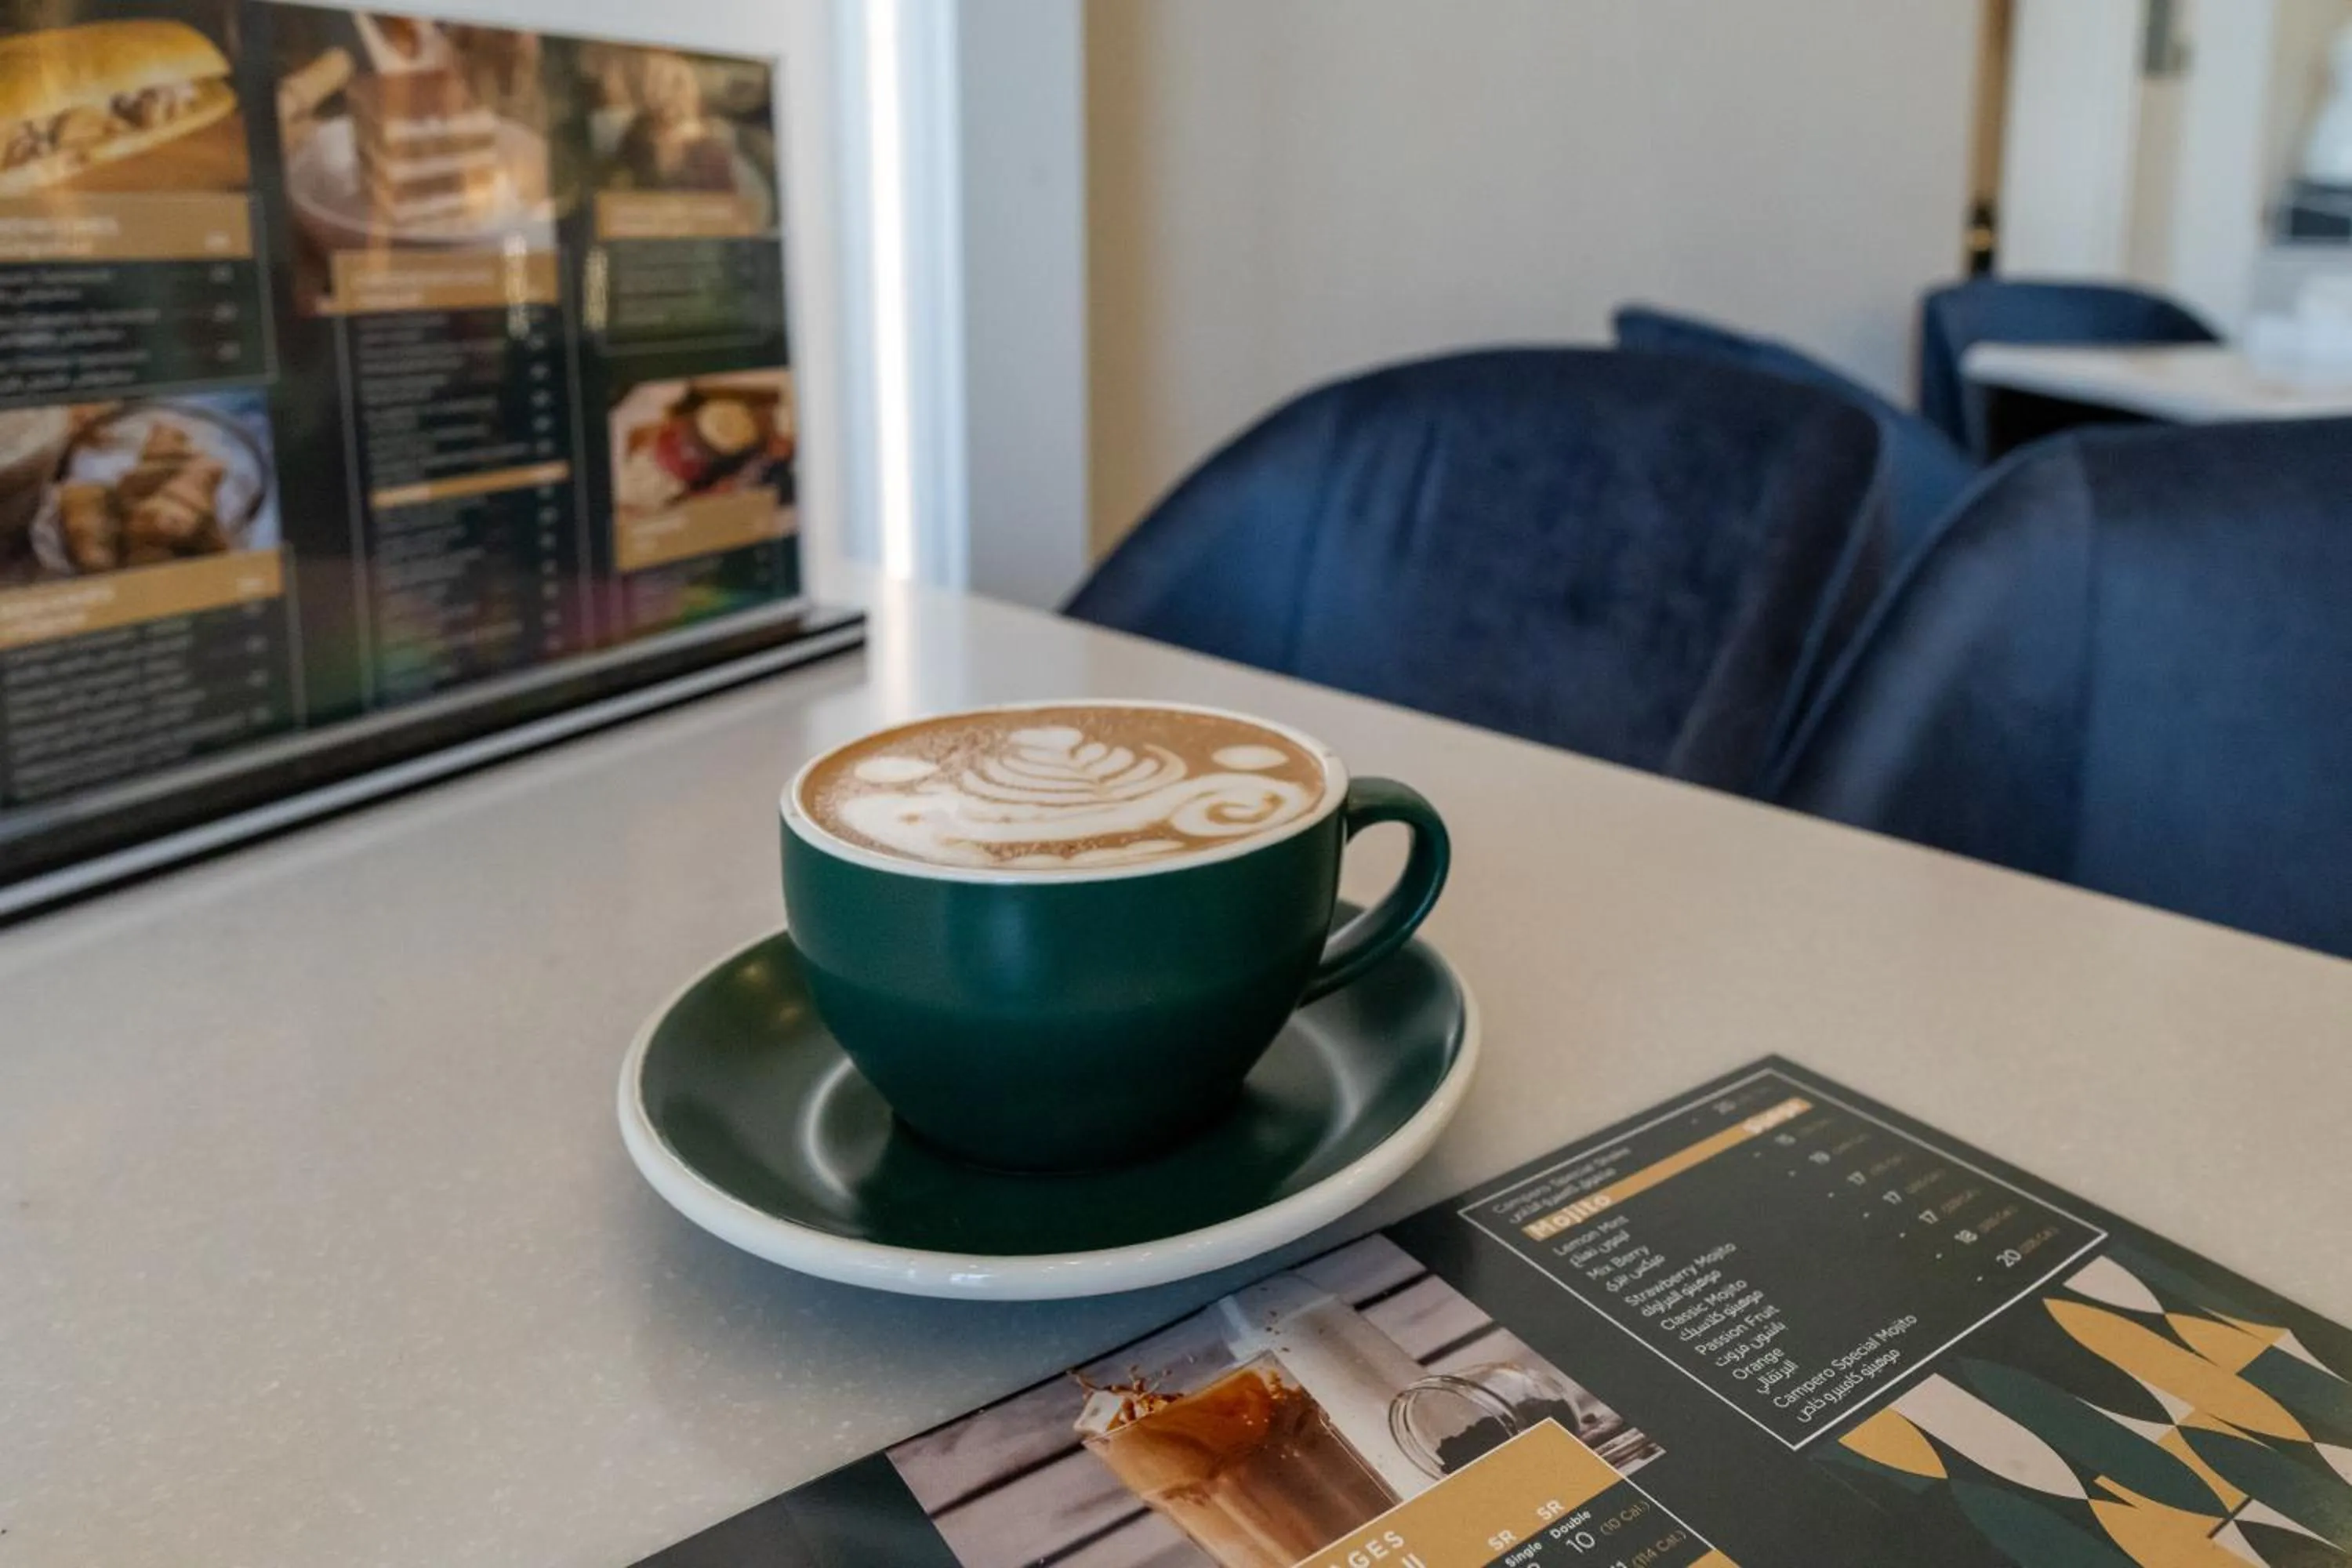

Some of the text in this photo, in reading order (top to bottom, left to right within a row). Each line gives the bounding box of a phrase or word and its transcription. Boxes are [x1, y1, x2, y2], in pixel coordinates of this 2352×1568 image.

[1882, 1190, 1903, 1204] 17
[1530, 1195, 1612, 1240] Mojito
[1552, 1215, 1630, 1256] Lemon Mint
[1918, 1210, 1939, 1225] 17
[1586, 1245, 1650, 1280] Mix Berry
[1624, 1243, 1737, 1307] Strawberry Mojito
[1996, 1249, 2022, 1268] 20
[1660, 1279, 1748, 1330] Classic Mojito
[1694, 1305, 1780, 1355] Passion Fruit
[1732, 1348, 1784, 1380] Orange
[1773, 1315, 1918, 1408] Campero Special Mojito
[1860, 1348, 1900, 1379] موهيتو
[1487, 1499, 1565, 1552] SR SR
[1504, 1510, 1592, 1568] Single Double
[1565, 1530, 1596, 1555] 10
[1329, 1530, 1405, 1568] GES
